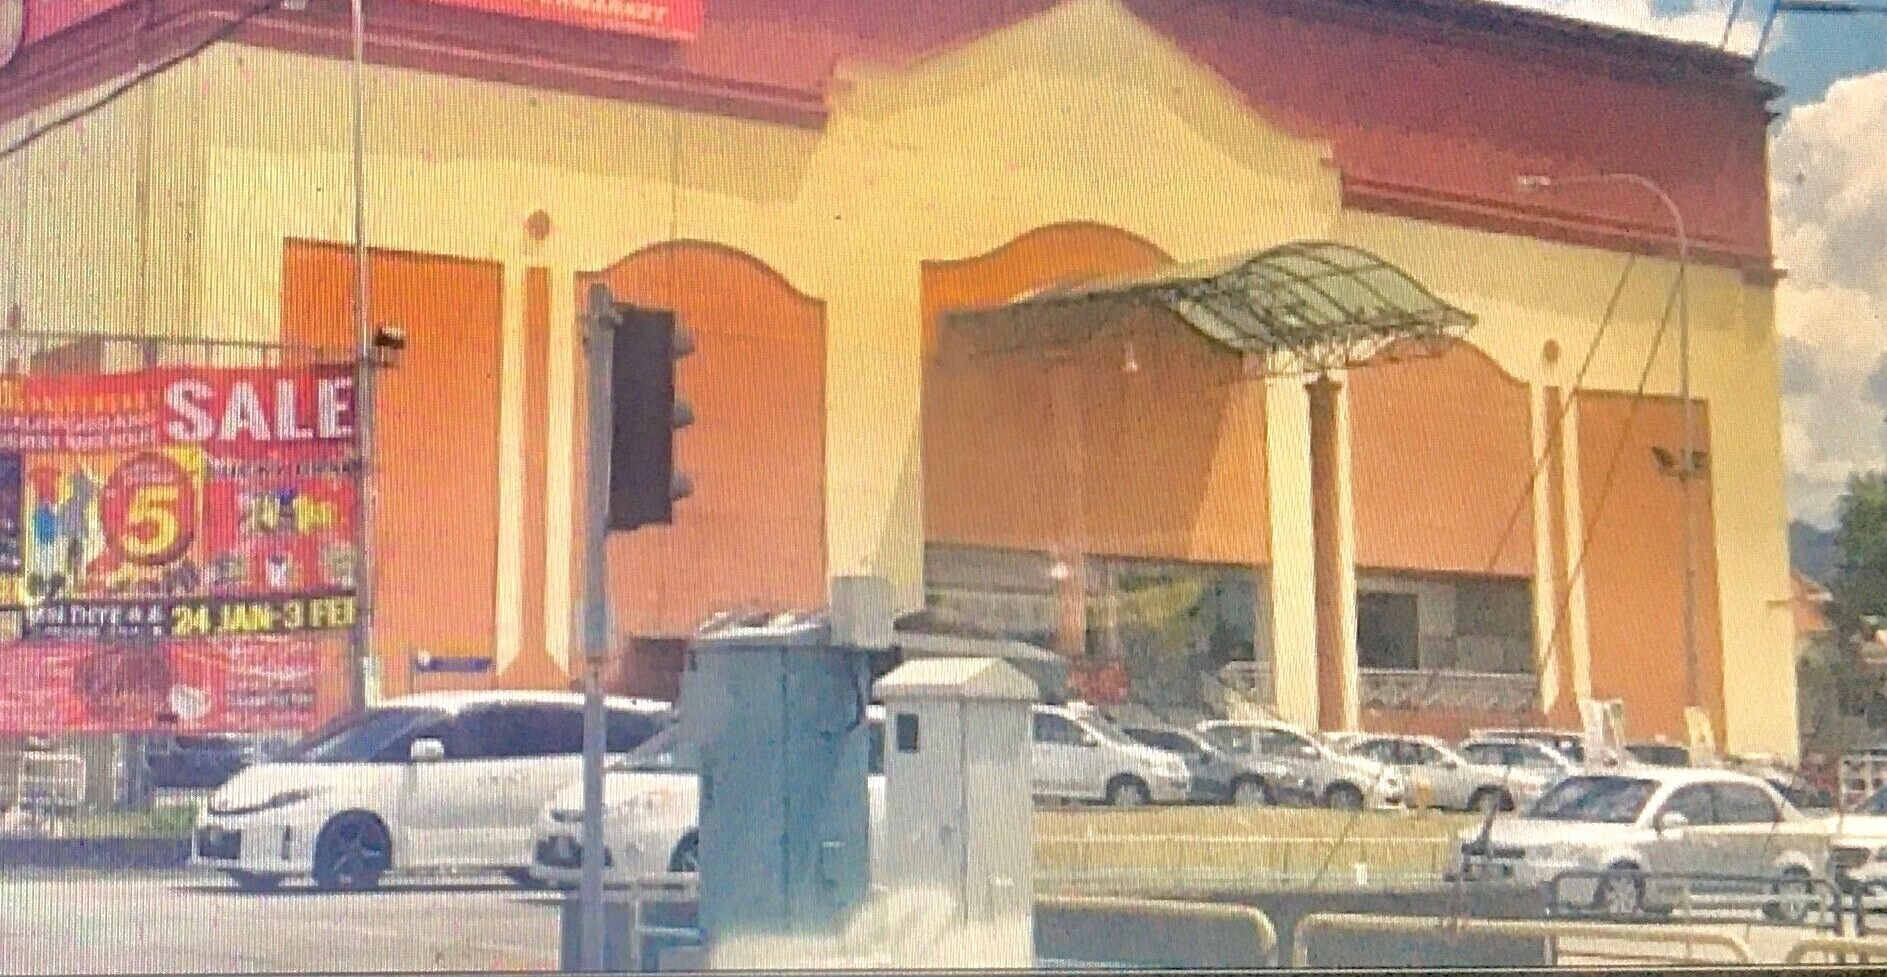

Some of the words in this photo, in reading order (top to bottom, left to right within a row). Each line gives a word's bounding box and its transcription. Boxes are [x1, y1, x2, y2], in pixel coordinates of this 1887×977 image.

[164, 378, 354, 442] SALE
[121, 484, 181, 557] 5
[172, 605, 210, 636] 24
